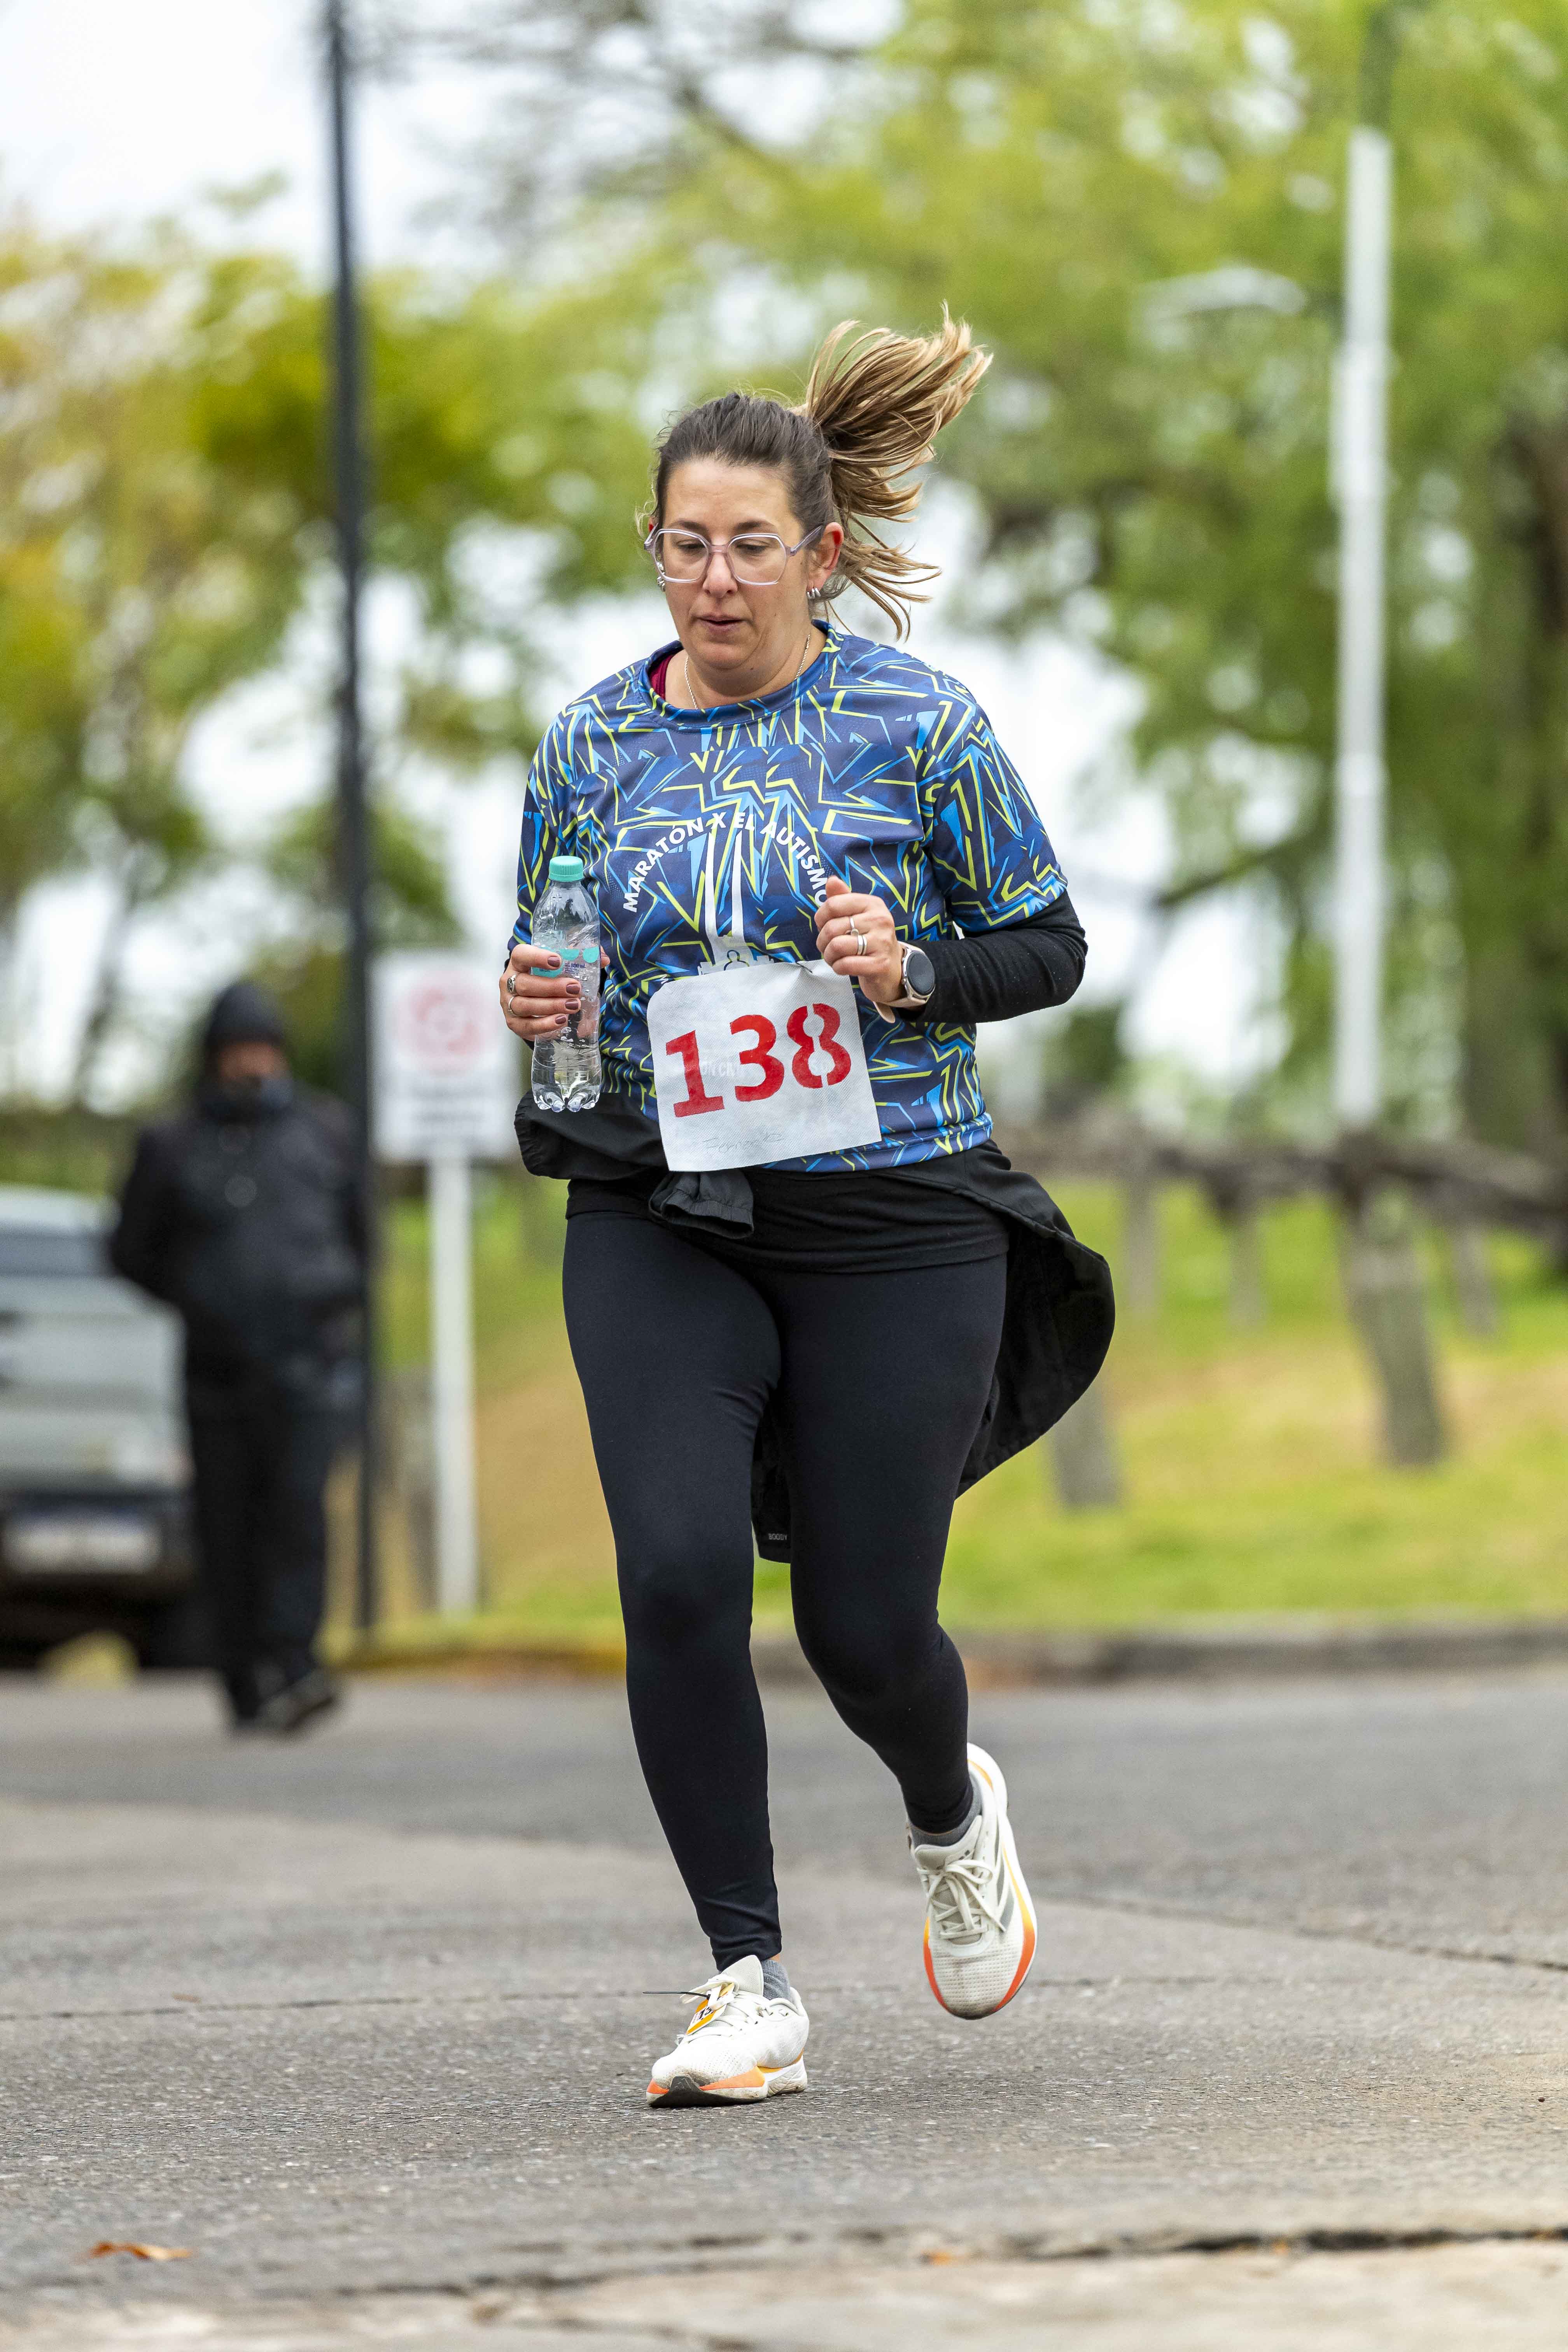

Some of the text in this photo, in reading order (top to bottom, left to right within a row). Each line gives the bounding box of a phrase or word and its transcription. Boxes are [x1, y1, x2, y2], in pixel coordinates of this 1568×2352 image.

[623, 812, 828, 912] MARATÓN X EL AUTISMO
[665, 1003, 851, 1117] 138
